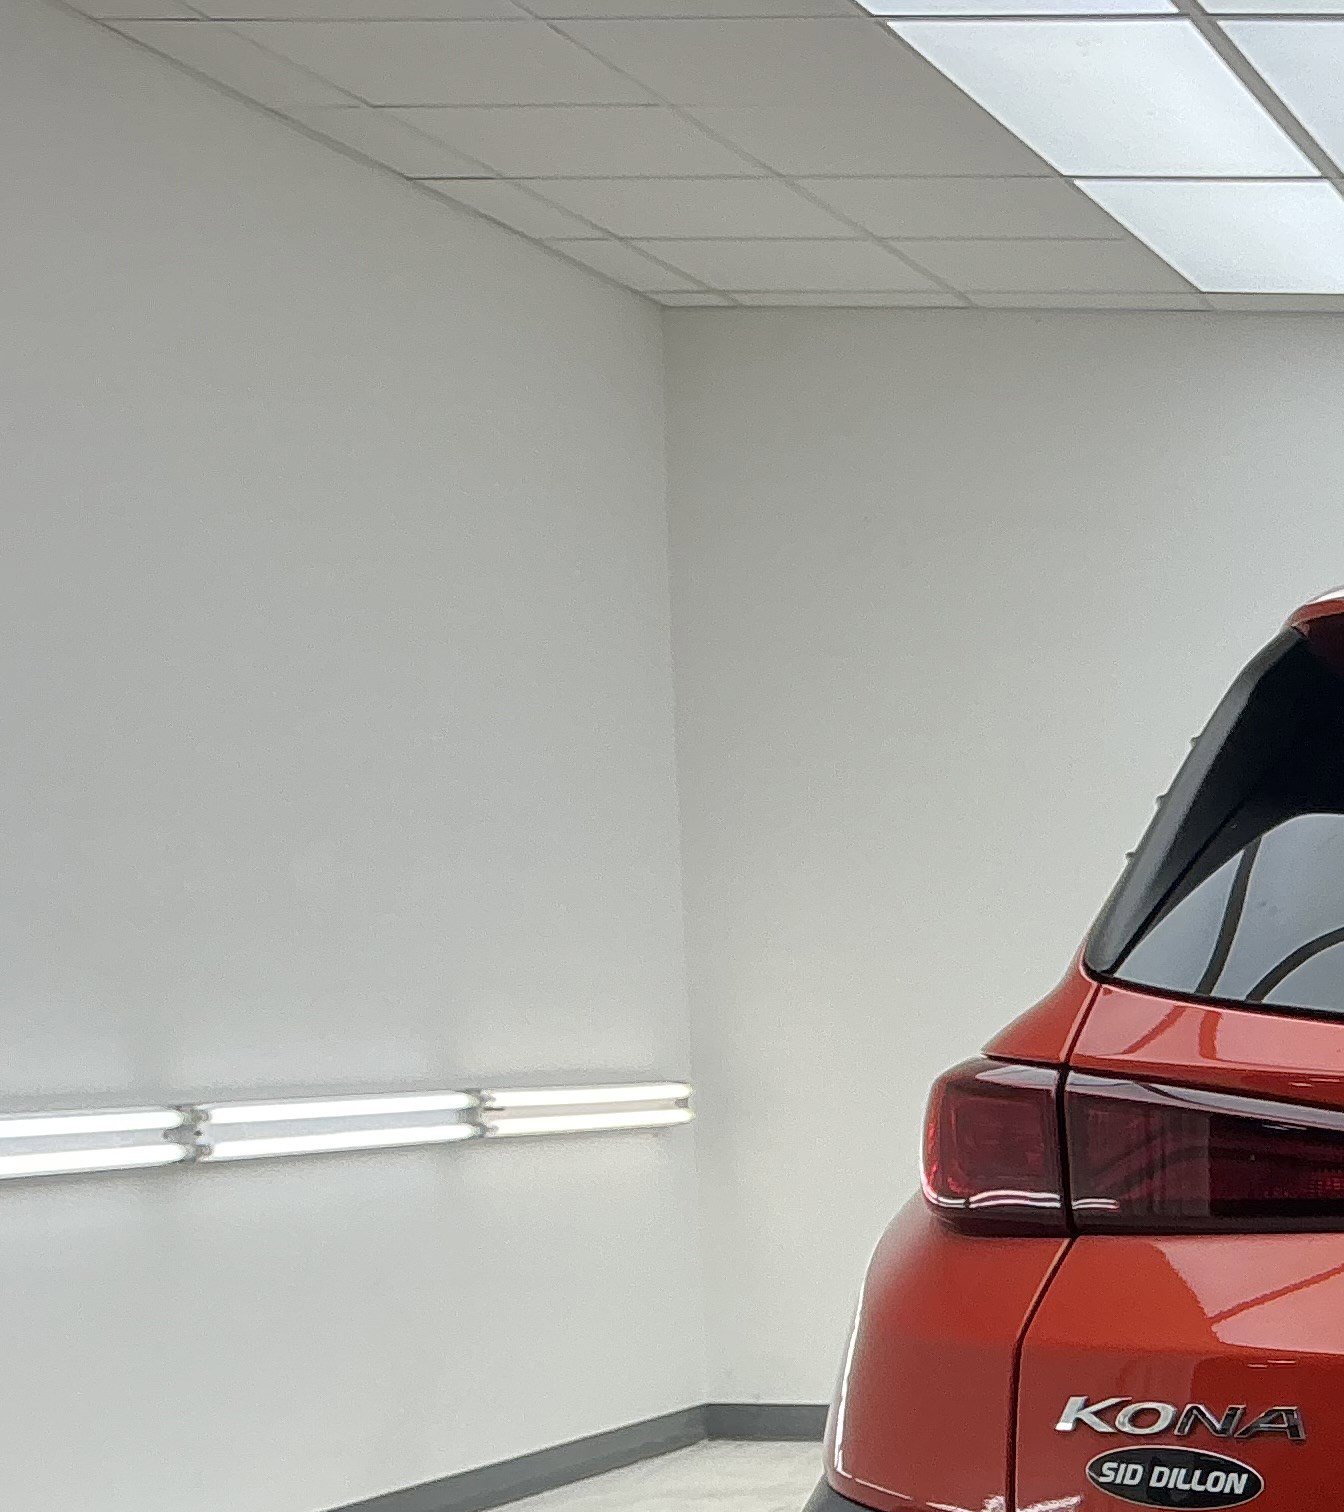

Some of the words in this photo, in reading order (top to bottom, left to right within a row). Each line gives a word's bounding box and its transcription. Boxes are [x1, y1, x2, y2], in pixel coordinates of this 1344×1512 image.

[1054, 1395, 1306, 1440] KONA
[1099, 1461, 1144, 1486] SID
[1150, 1466, 1249, 1495] DILLON
